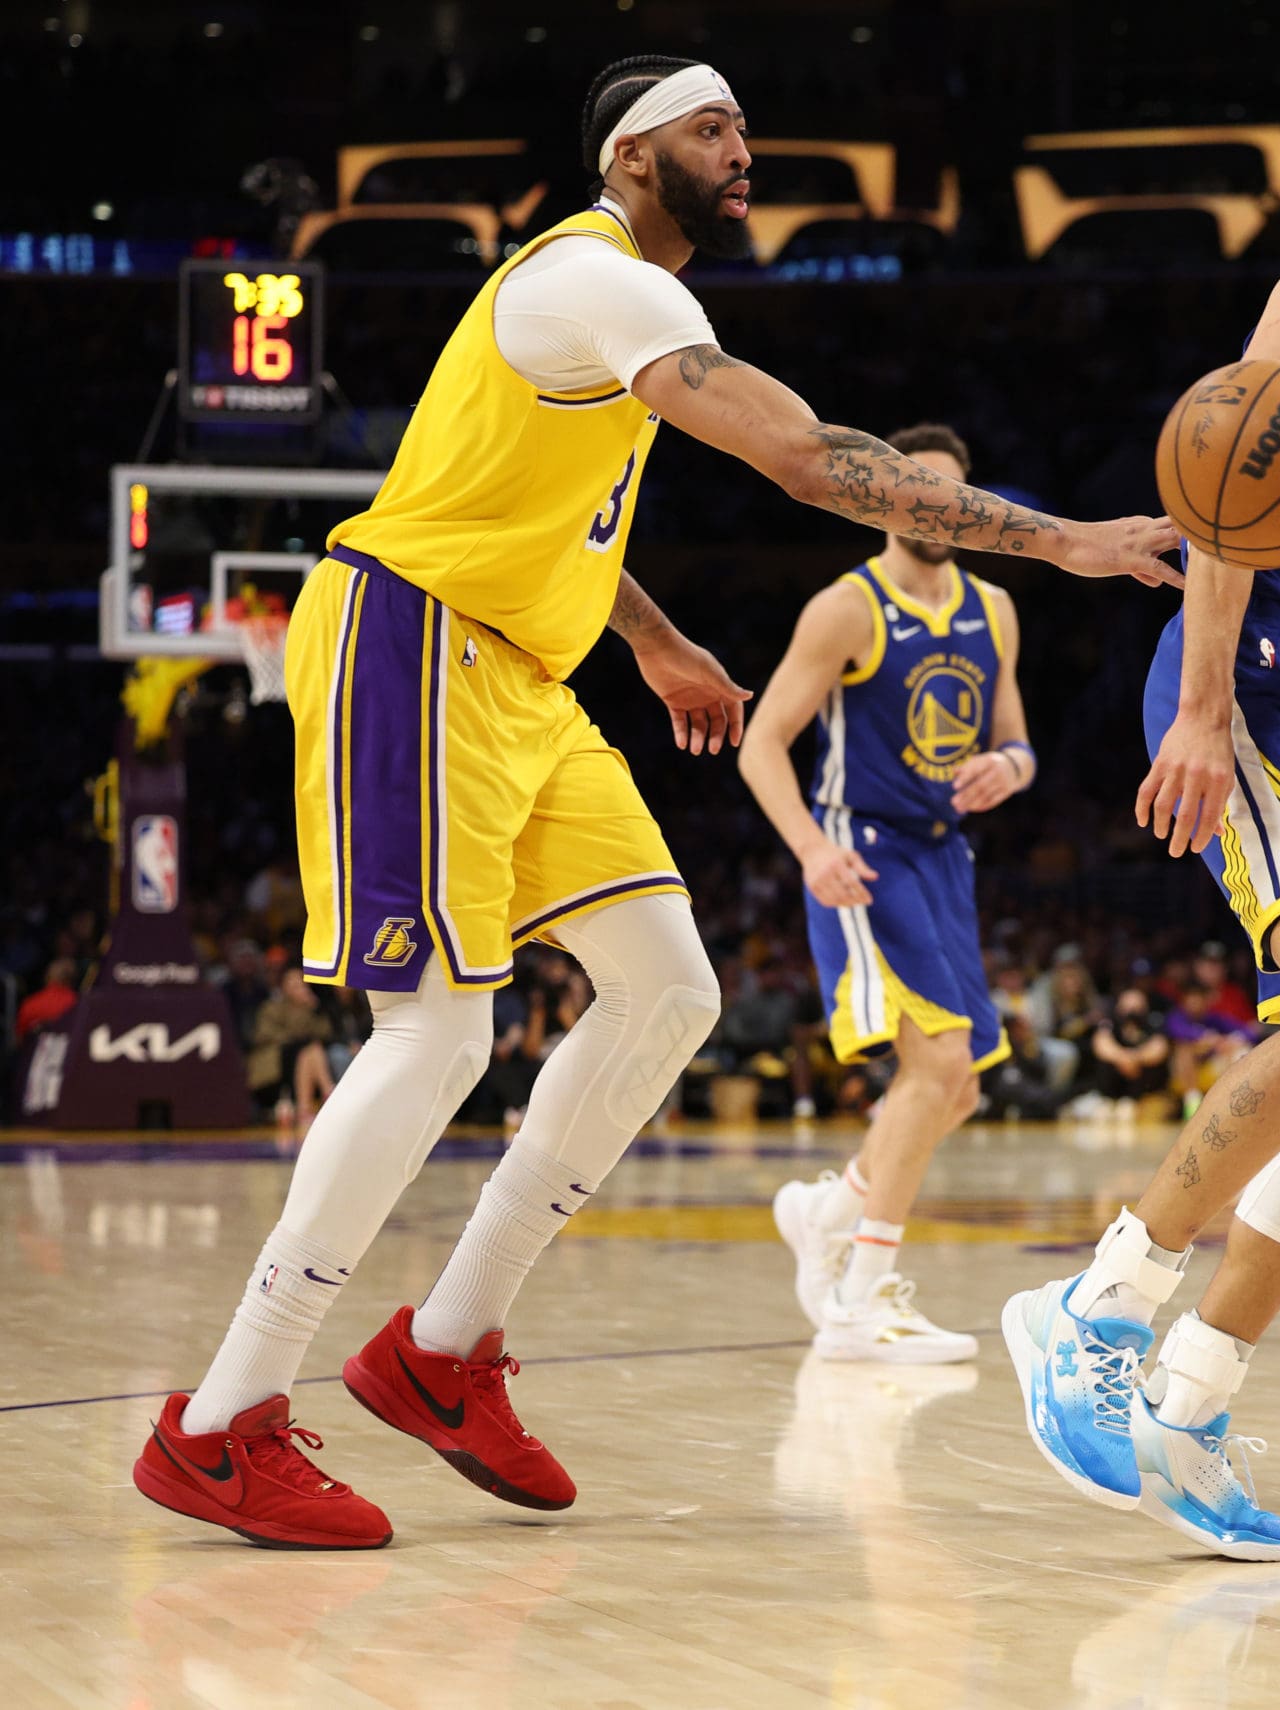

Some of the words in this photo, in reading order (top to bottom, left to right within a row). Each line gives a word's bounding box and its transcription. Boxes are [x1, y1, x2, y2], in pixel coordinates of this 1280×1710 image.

[223, 272, 304, 318] 7:35
[233, 315, 292, 381] 16
[583, 446, 637, 554] 3
